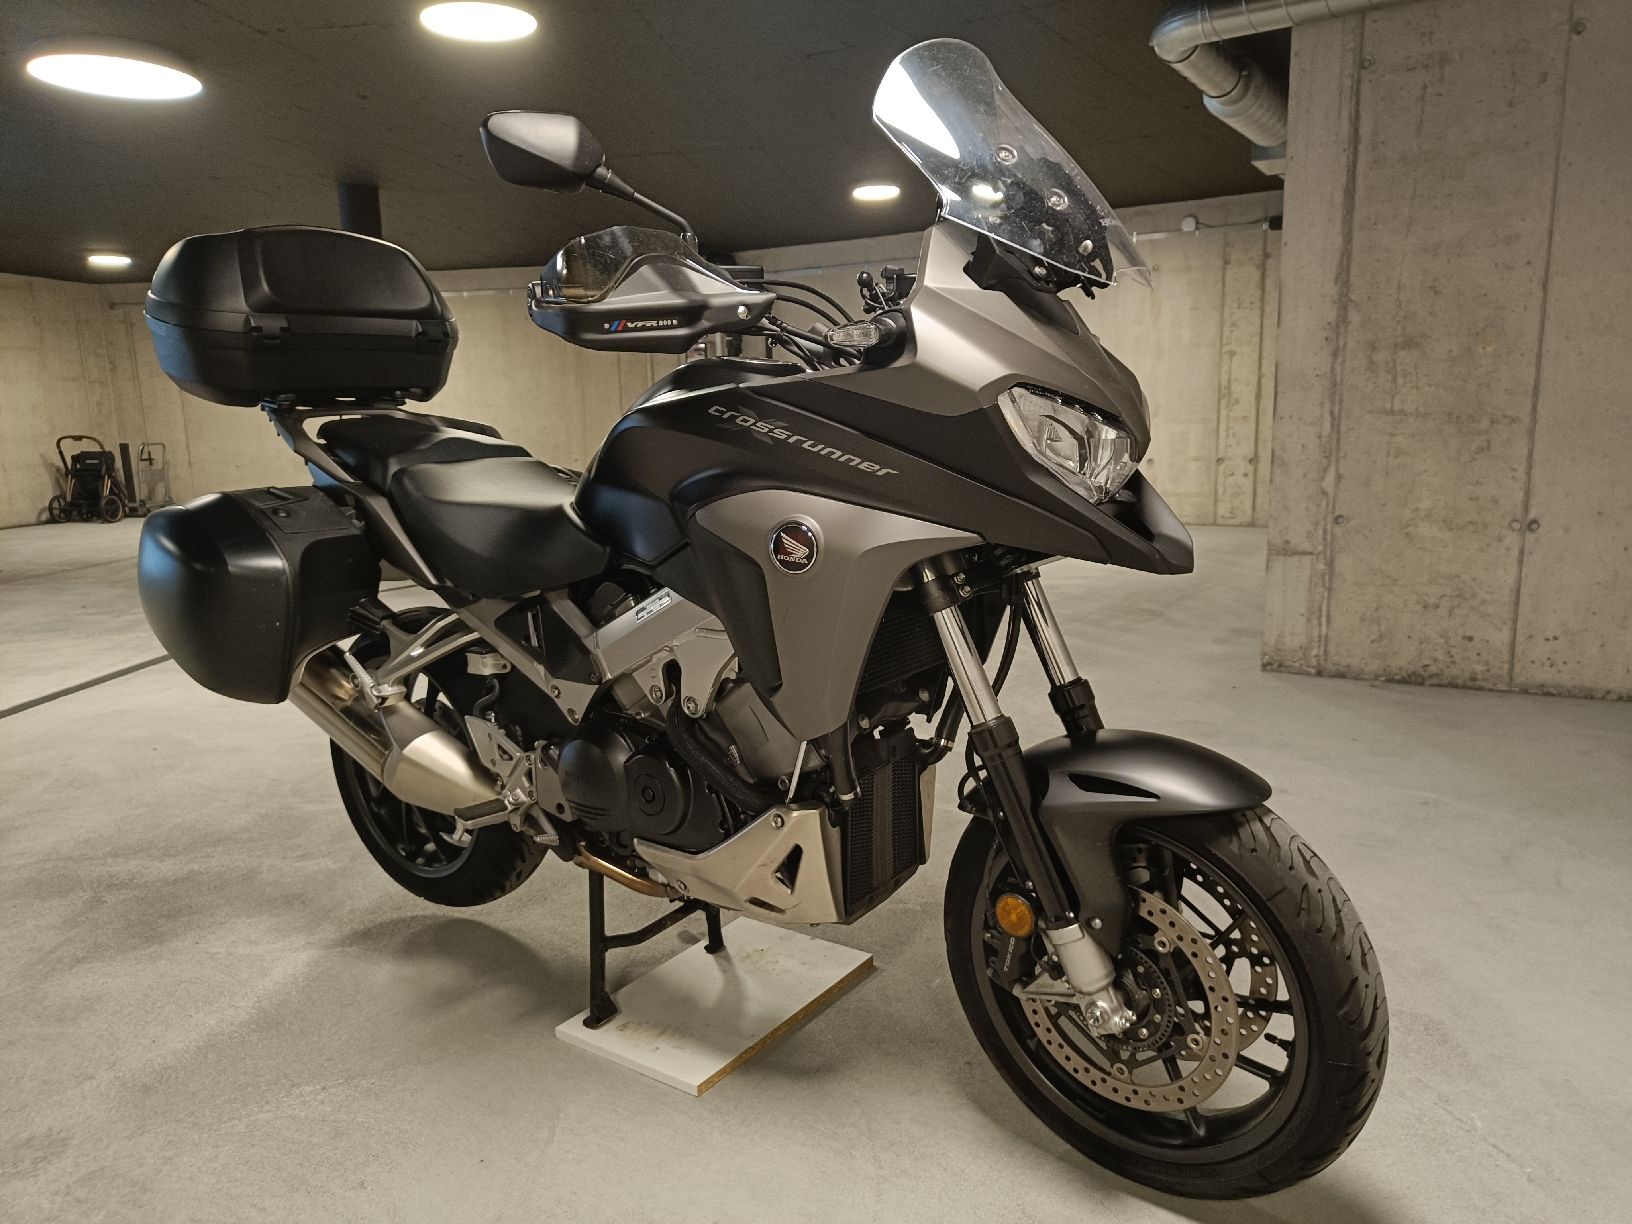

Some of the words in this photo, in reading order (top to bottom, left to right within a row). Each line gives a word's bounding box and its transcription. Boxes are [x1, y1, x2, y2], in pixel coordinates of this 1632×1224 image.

[626, 320, 658, 328] VFR
[708, 405, 900, 476] crossrunner
[777, 554, 809, 564] HONDA
